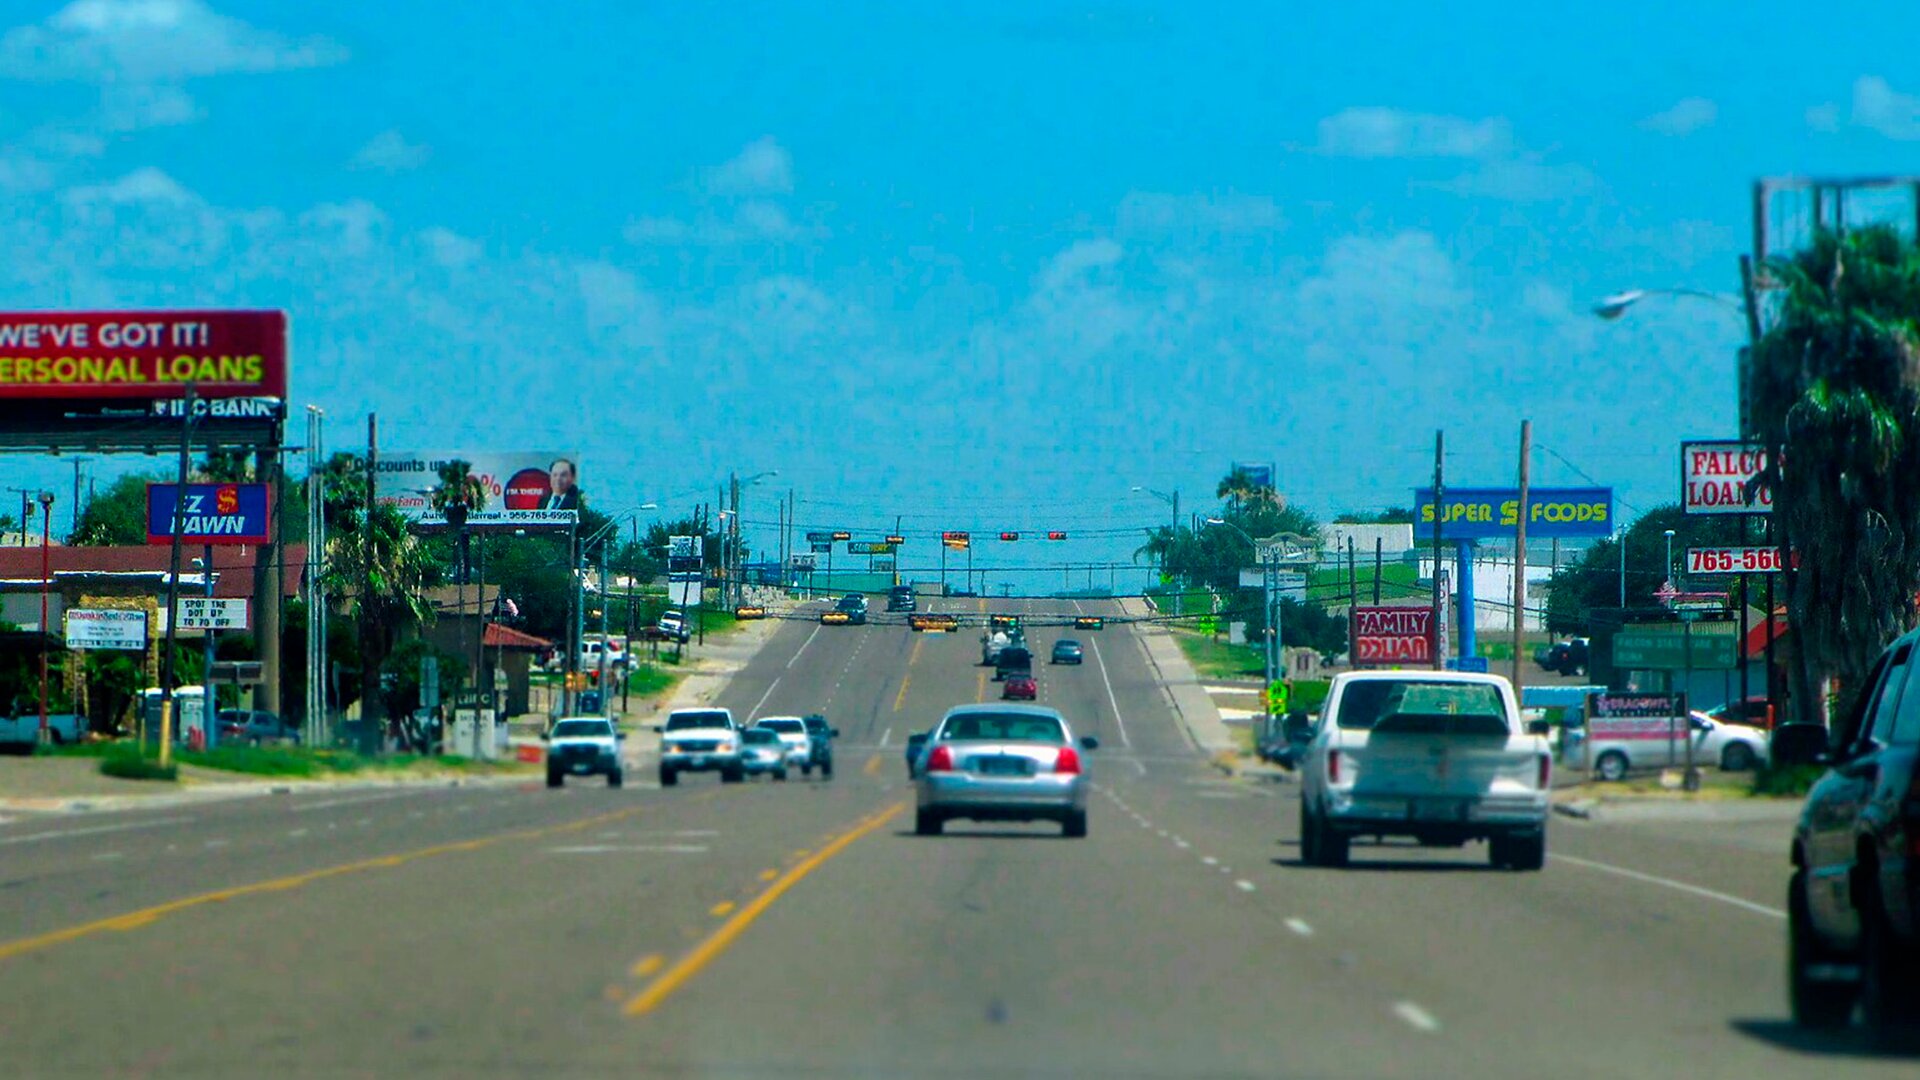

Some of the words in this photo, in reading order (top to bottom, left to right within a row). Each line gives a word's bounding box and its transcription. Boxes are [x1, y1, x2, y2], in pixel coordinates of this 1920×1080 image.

[0, 323, 88, 348] WE'VE
[98, 323, 164, 348] GOT
[172, 322, 208, 347] IT!
[156, 355, 263, 383] LOANS
[211, 398, 270, 416] BANK
[1531, 503, 1607, 522] FOODS
[185, 600, 205, 608] SPOT
[211, 600, 227, 608] THE
[188, 609, 204, 617] DOT
[210, 609, 223, 617] UP
[183, 618, 194, 626] TO
[199, 618, 210, 627] 70
[215, 618, 230, 626] OFF
[1357, 611, 1431, 635] FAMILY
[1357, 635, 1428, 660] DOLLAR
